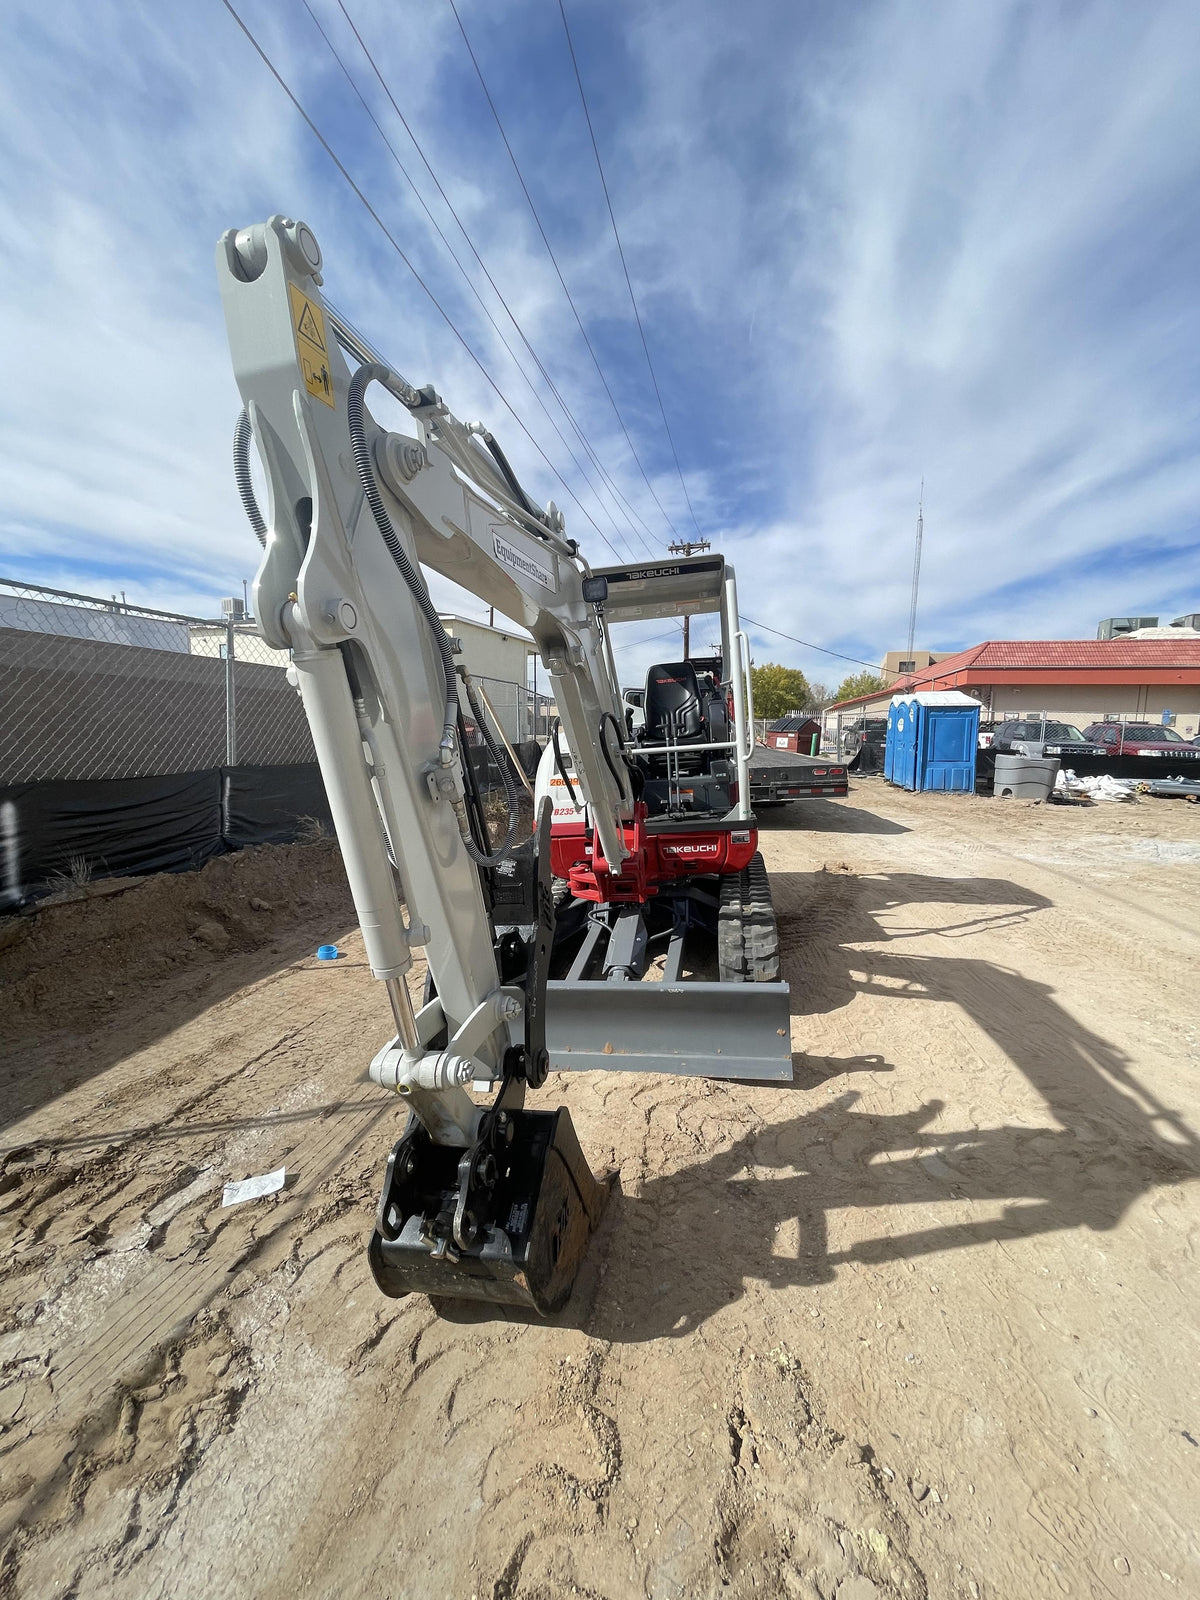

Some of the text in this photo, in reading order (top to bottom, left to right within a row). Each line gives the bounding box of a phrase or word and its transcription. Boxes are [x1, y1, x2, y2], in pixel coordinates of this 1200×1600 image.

[496, 539, 548, 584] EquipmentShare
[626, 567, 680, 580] TAKEUCHI
[663, 844, 718, 854] TAKEUCHI
